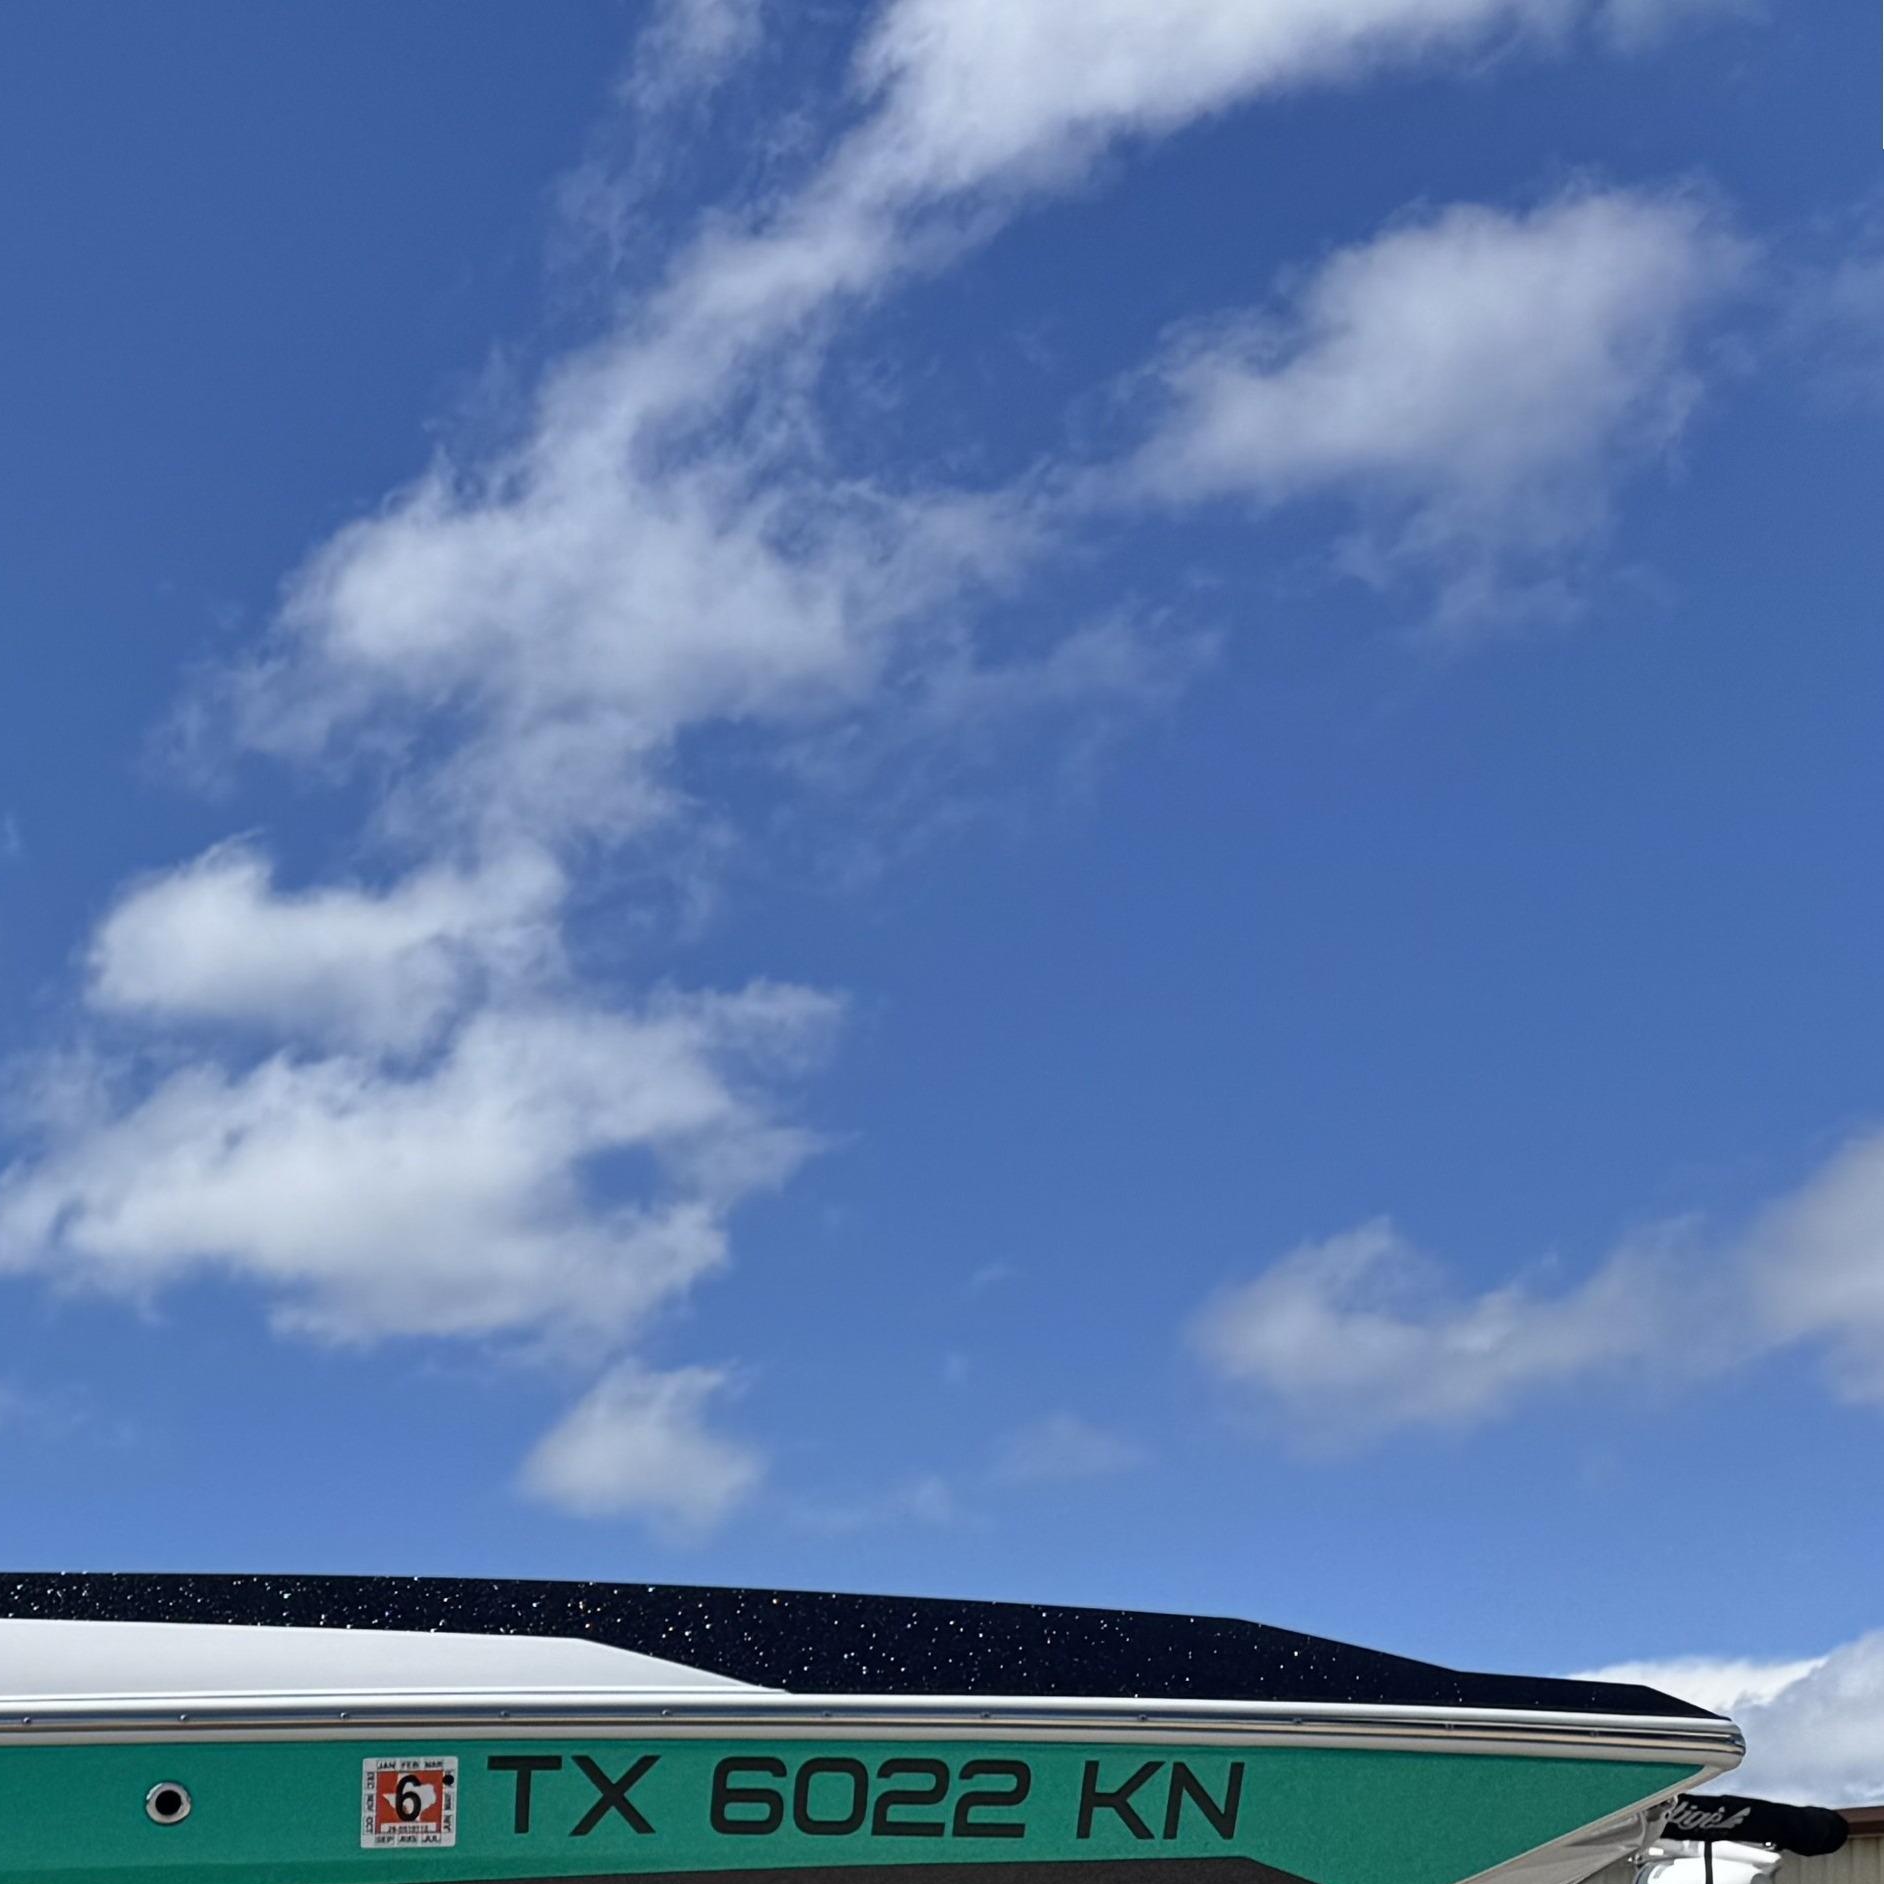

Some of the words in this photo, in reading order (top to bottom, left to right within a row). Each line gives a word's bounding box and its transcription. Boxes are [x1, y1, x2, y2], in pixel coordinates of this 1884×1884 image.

[395, 1774, 422, 1822] 6
[486, 1754, 661, 1837] TX
[709, 1755, 1032, 1839] 6022
[1075, 1759, 1245, 1841] KN
